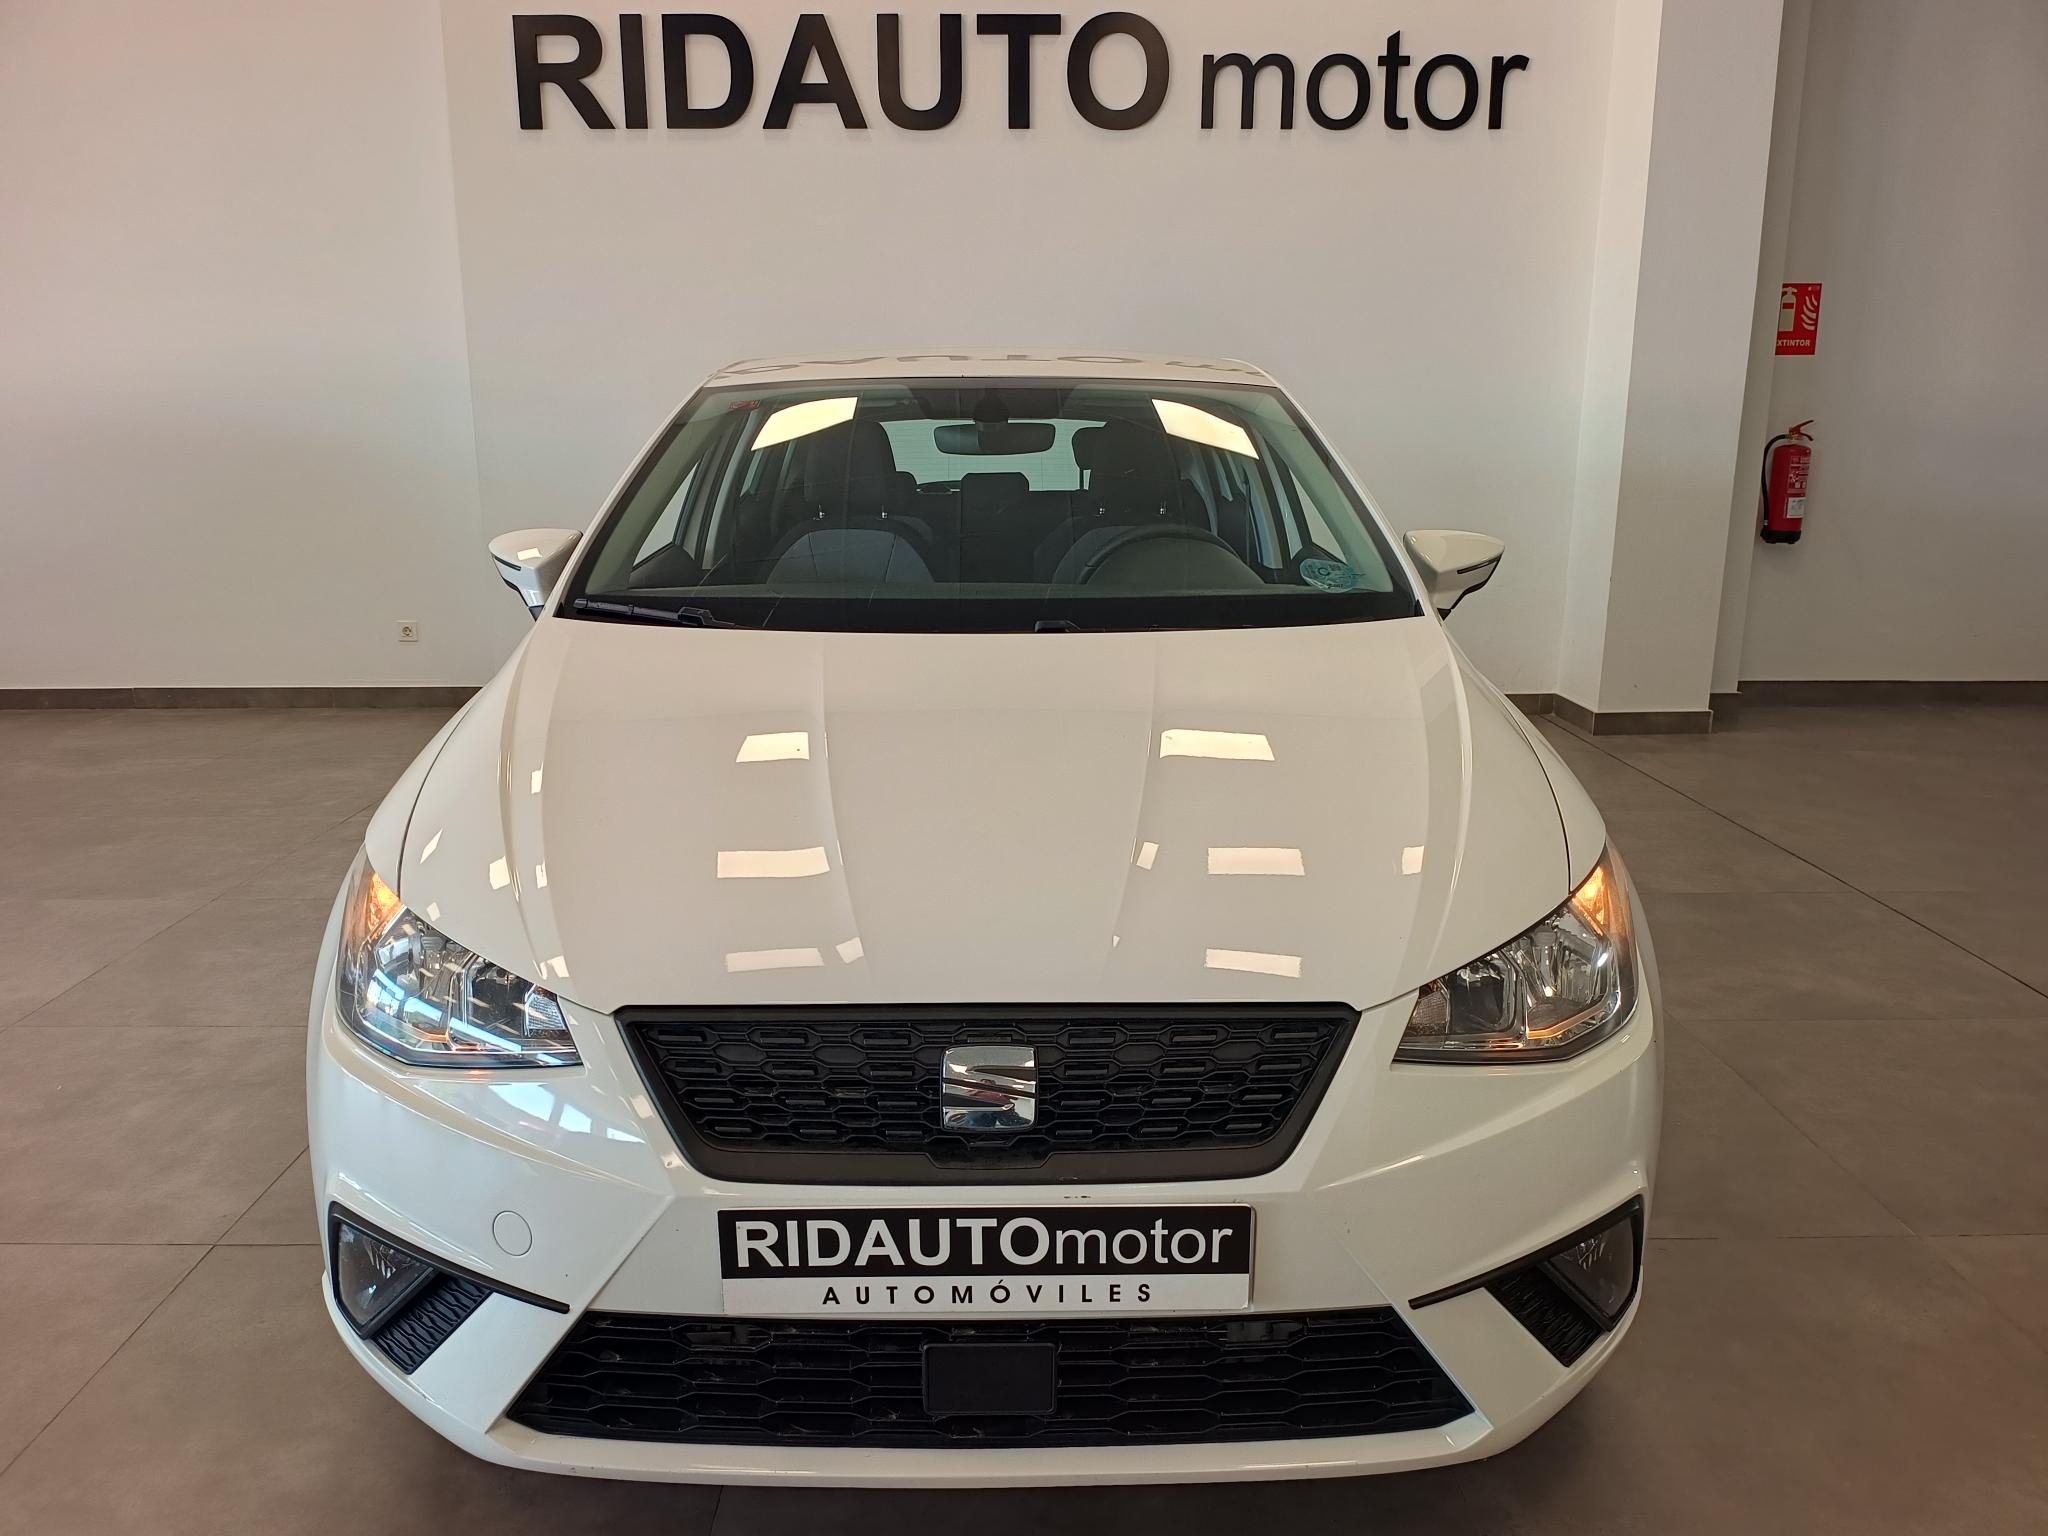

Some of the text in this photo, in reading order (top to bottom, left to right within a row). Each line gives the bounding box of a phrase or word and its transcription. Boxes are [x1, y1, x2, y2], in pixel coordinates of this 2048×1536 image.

[512, 12, 1530, 131] RIDAUTO motor
[1777, 339, 1811, 347] XTINTOR
[735, 1216, 1233, 1268] RIDAUTOmotor
[822, 1279, 1151, 1305] AUTOMÓVILES
